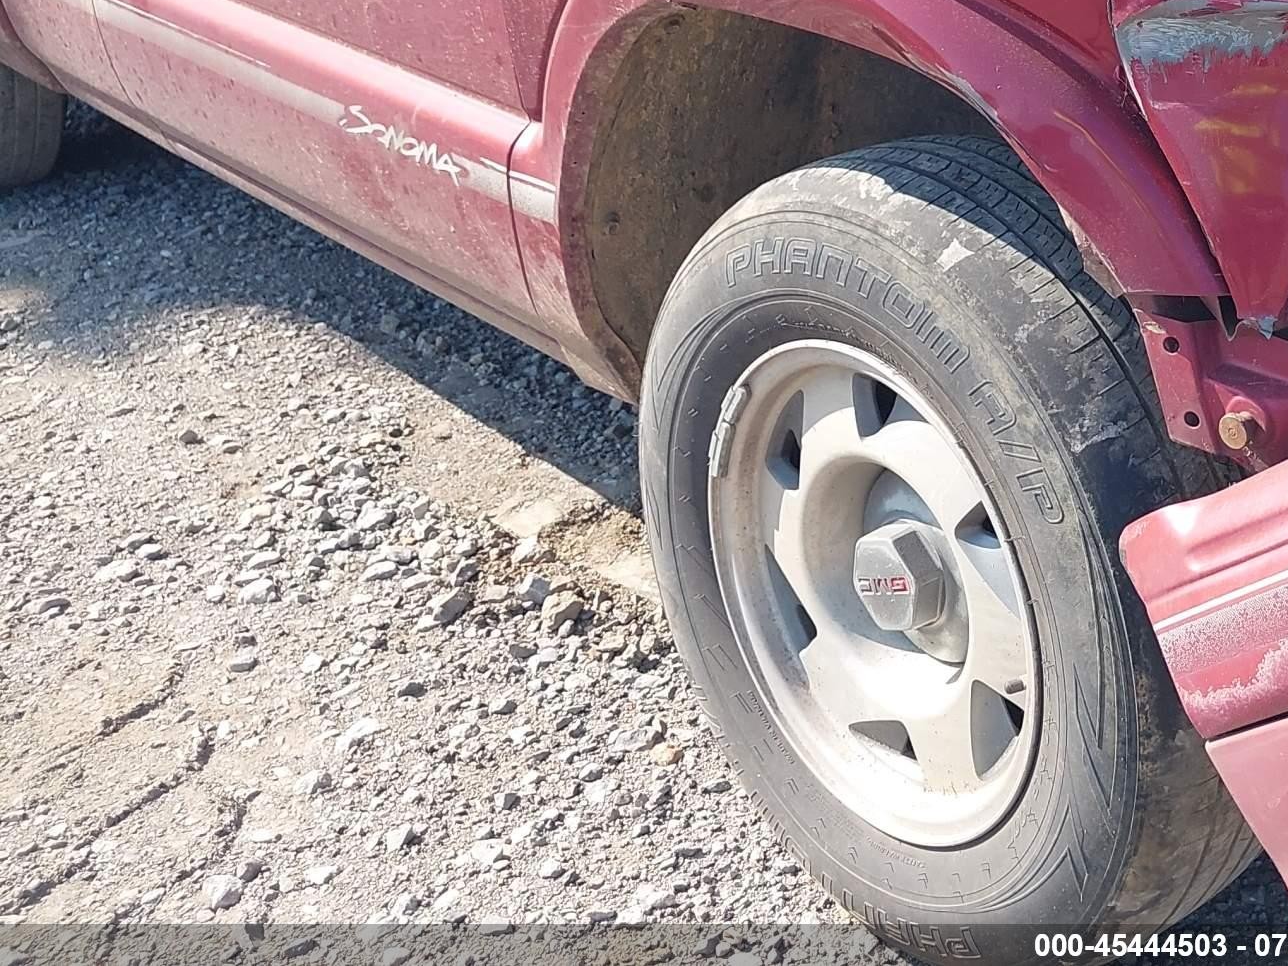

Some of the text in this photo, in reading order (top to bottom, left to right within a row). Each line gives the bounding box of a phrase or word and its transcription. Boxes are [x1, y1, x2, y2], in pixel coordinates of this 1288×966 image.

[338, 104, 463, 187] SONOMA
[725, 236, 971, 374] PHANTOM
[857, 576, 912, 596] GMC
